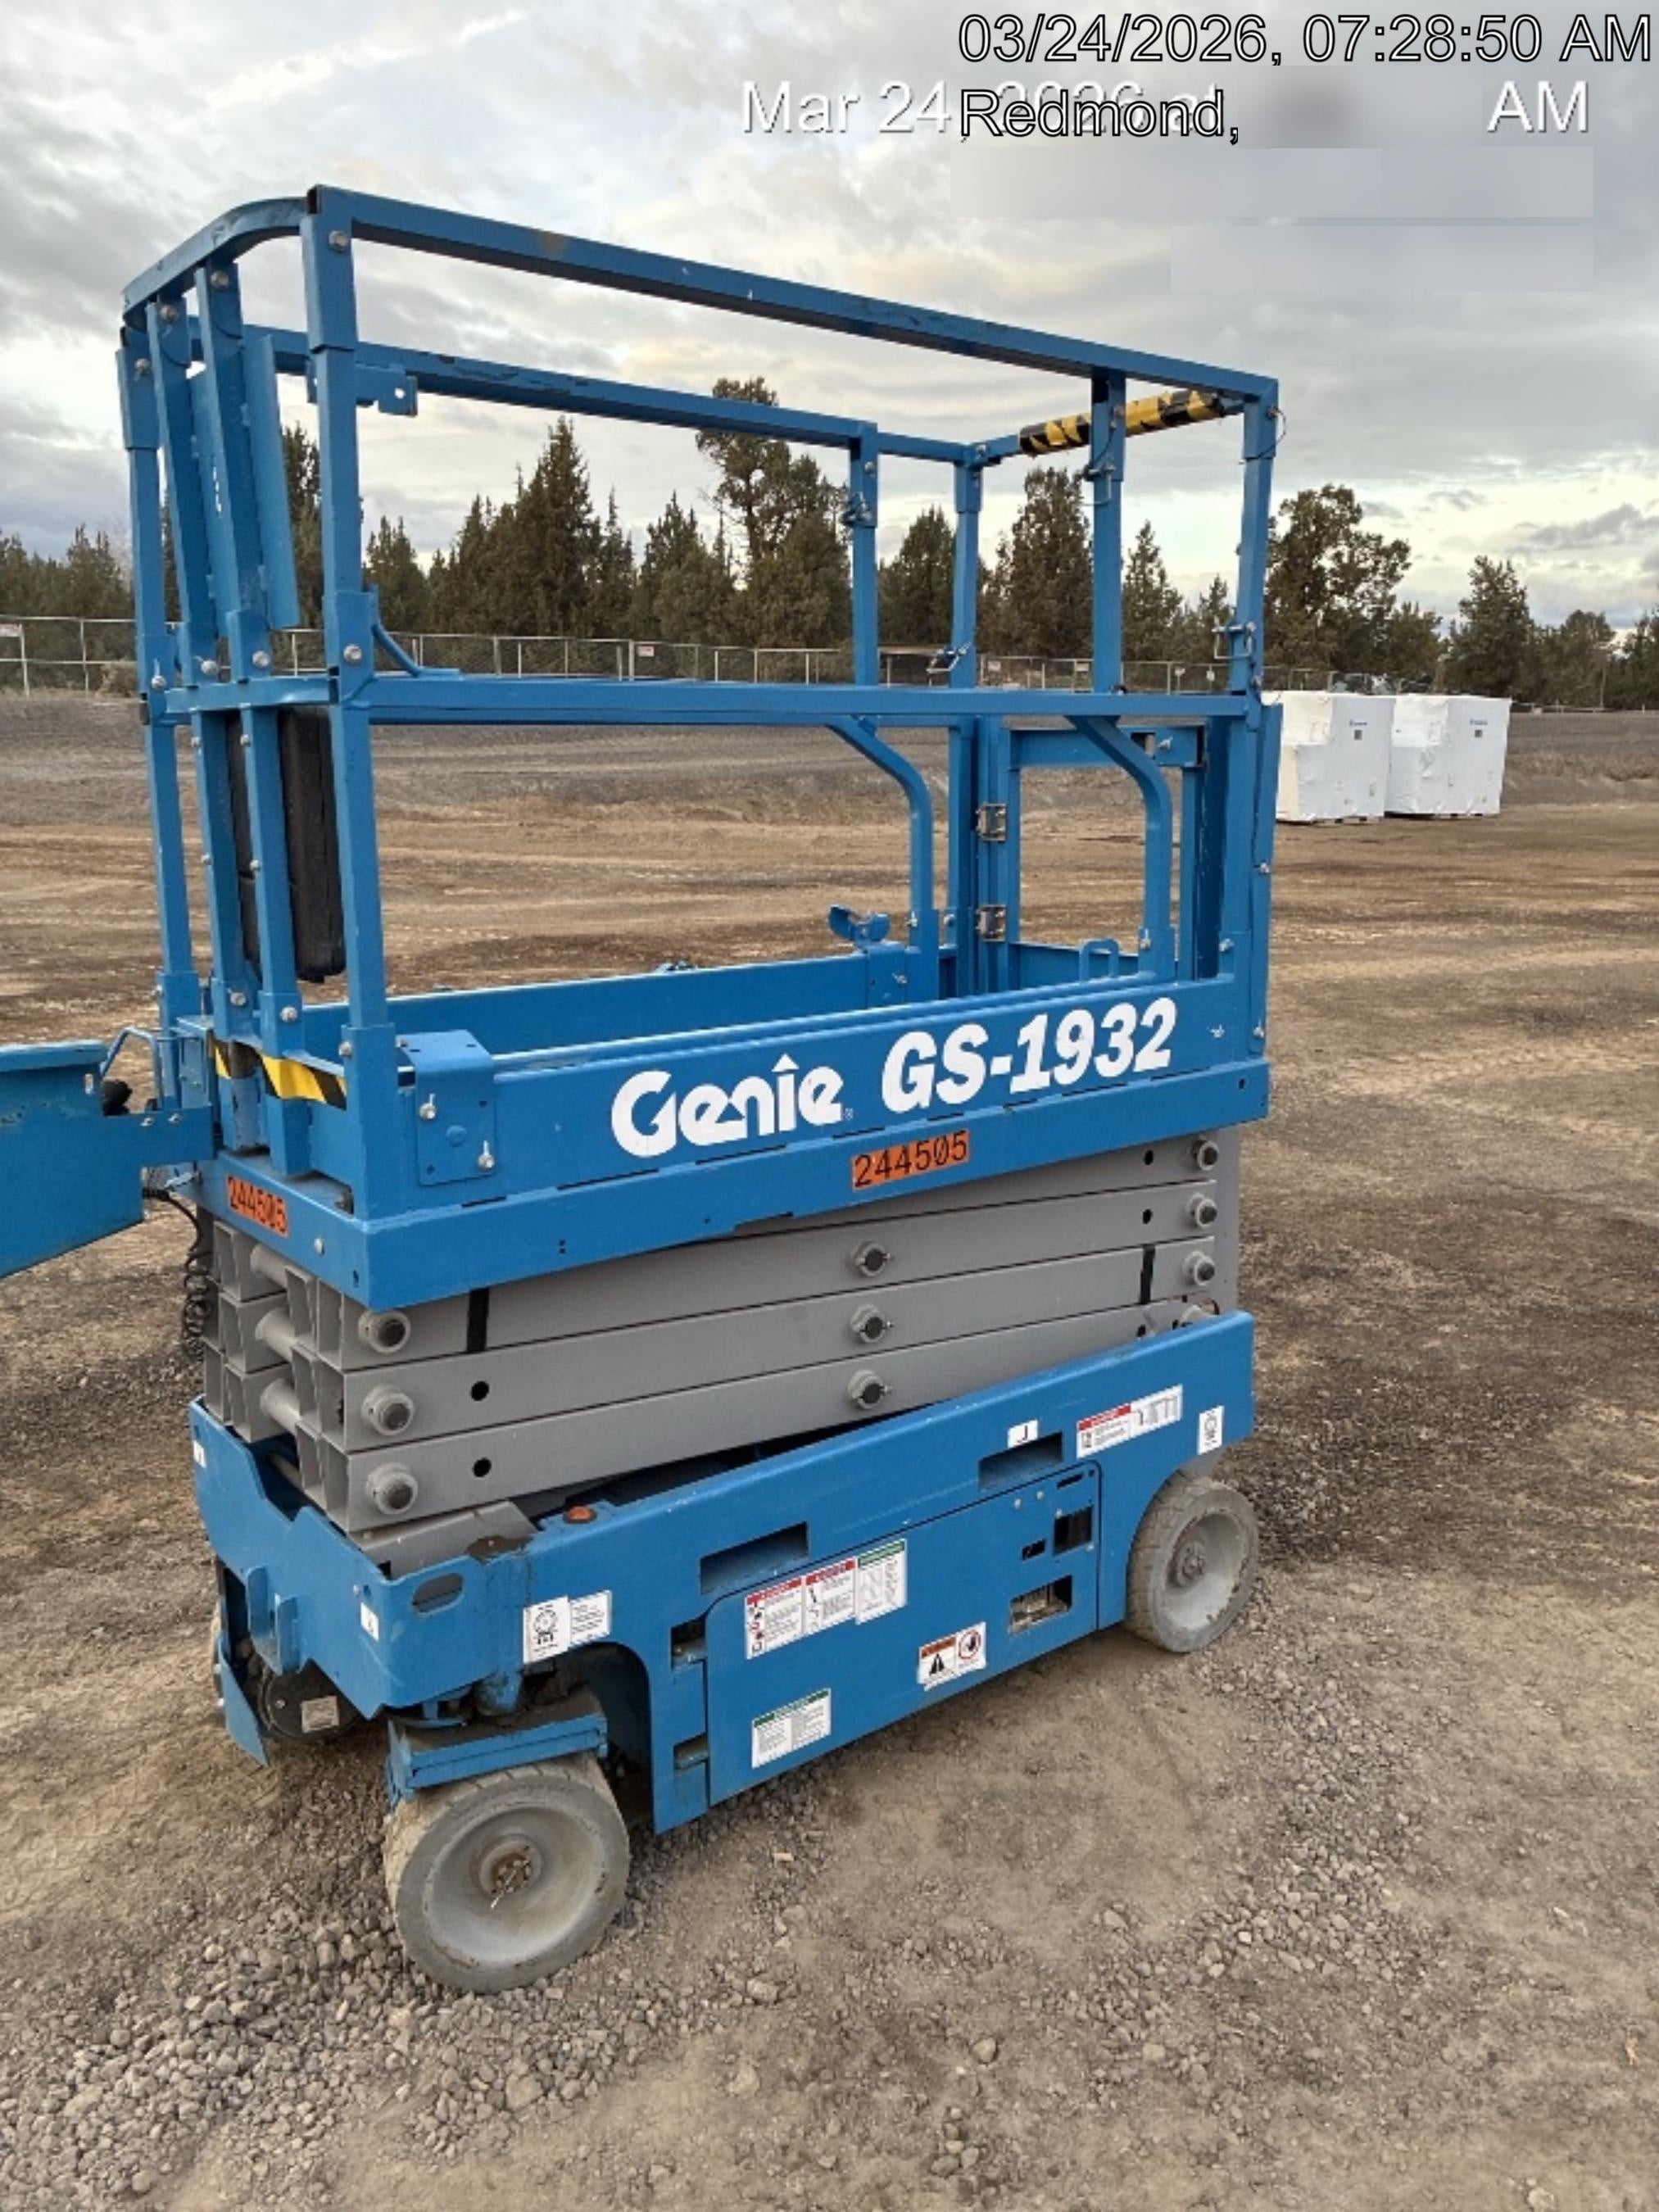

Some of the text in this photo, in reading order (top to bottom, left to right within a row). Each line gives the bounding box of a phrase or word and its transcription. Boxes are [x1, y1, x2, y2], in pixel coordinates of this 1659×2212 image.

[610, 996, 1177, 1158] Genie GS-1932
[854, 1129, 968, 1188] 244505
[227, 1176, 286, 1235] 244505
